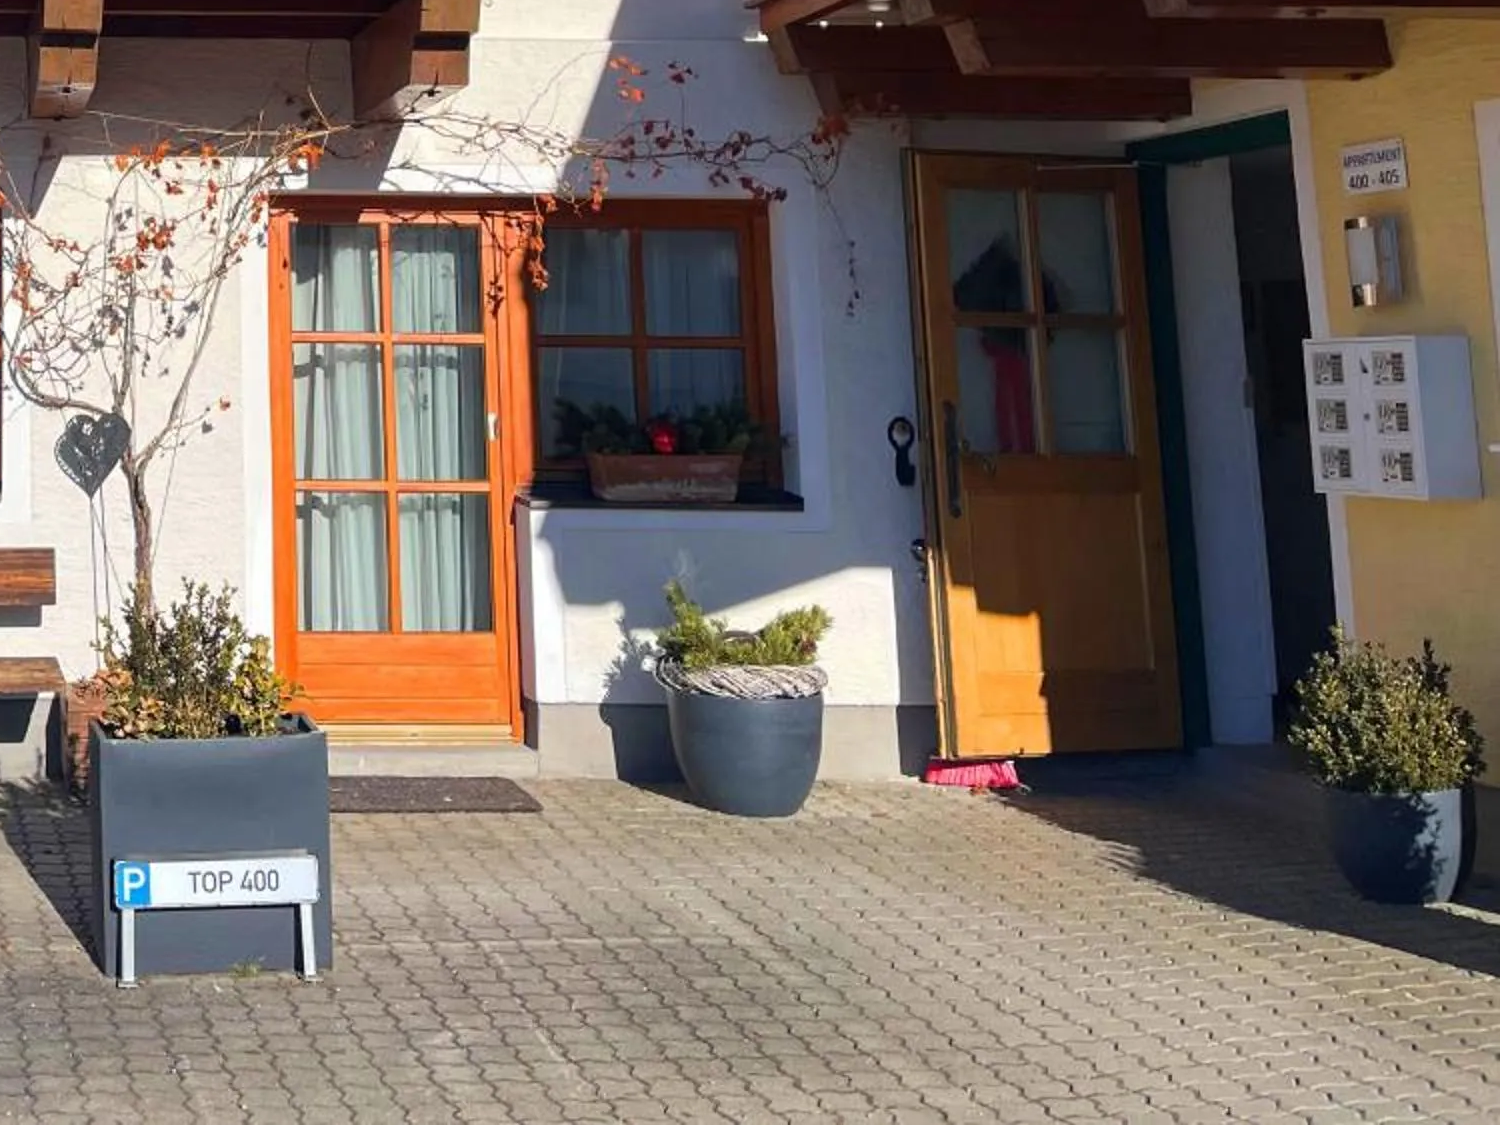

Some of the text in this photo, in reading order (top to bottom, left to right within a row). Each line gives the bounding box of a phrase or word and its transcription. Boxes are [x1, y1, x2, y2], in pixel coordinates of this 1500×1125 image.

[1348, 173, 1369, 189] 400
[122, 867, 280, 902] P TOP 400
